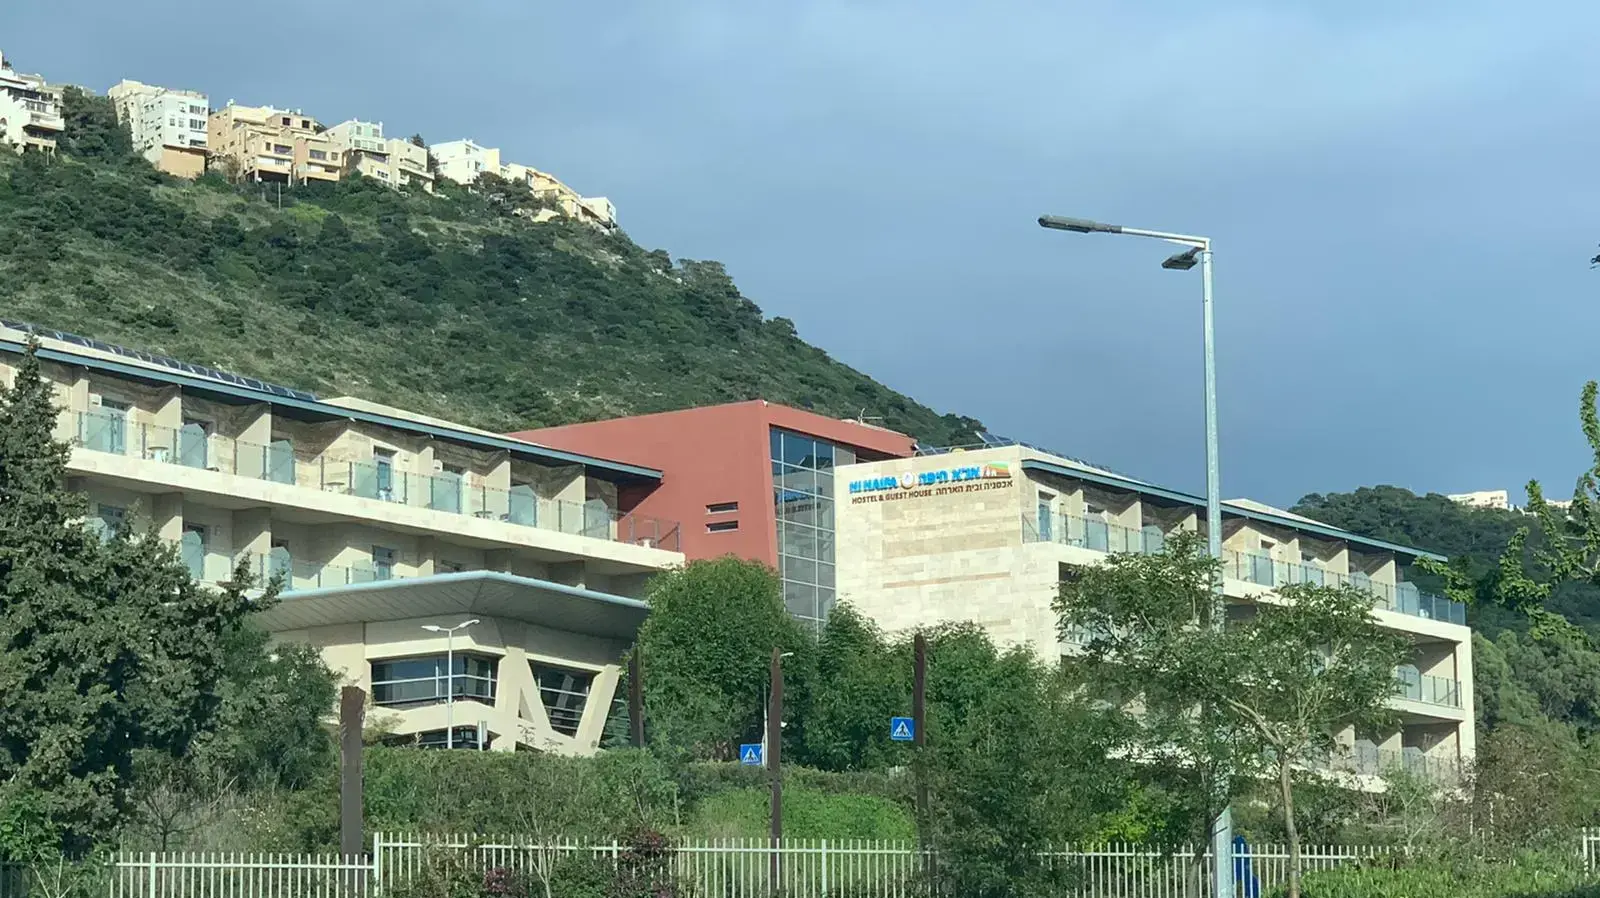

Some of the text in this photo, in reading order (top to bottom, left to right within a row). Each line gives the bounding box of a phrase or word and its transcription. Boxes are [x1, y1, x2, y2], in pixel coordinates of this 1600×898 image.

[863, 477, 897, 491] HAIFA
[918, 470, 949, 486] חיפה
[935, 480, 1013, 495] אכסניה ובית הארחה
[852, 495, 878, 504] HOSTEL
[885, 492, 907, 500] GUEST
[909, 489, 932, 498] HOUSE
